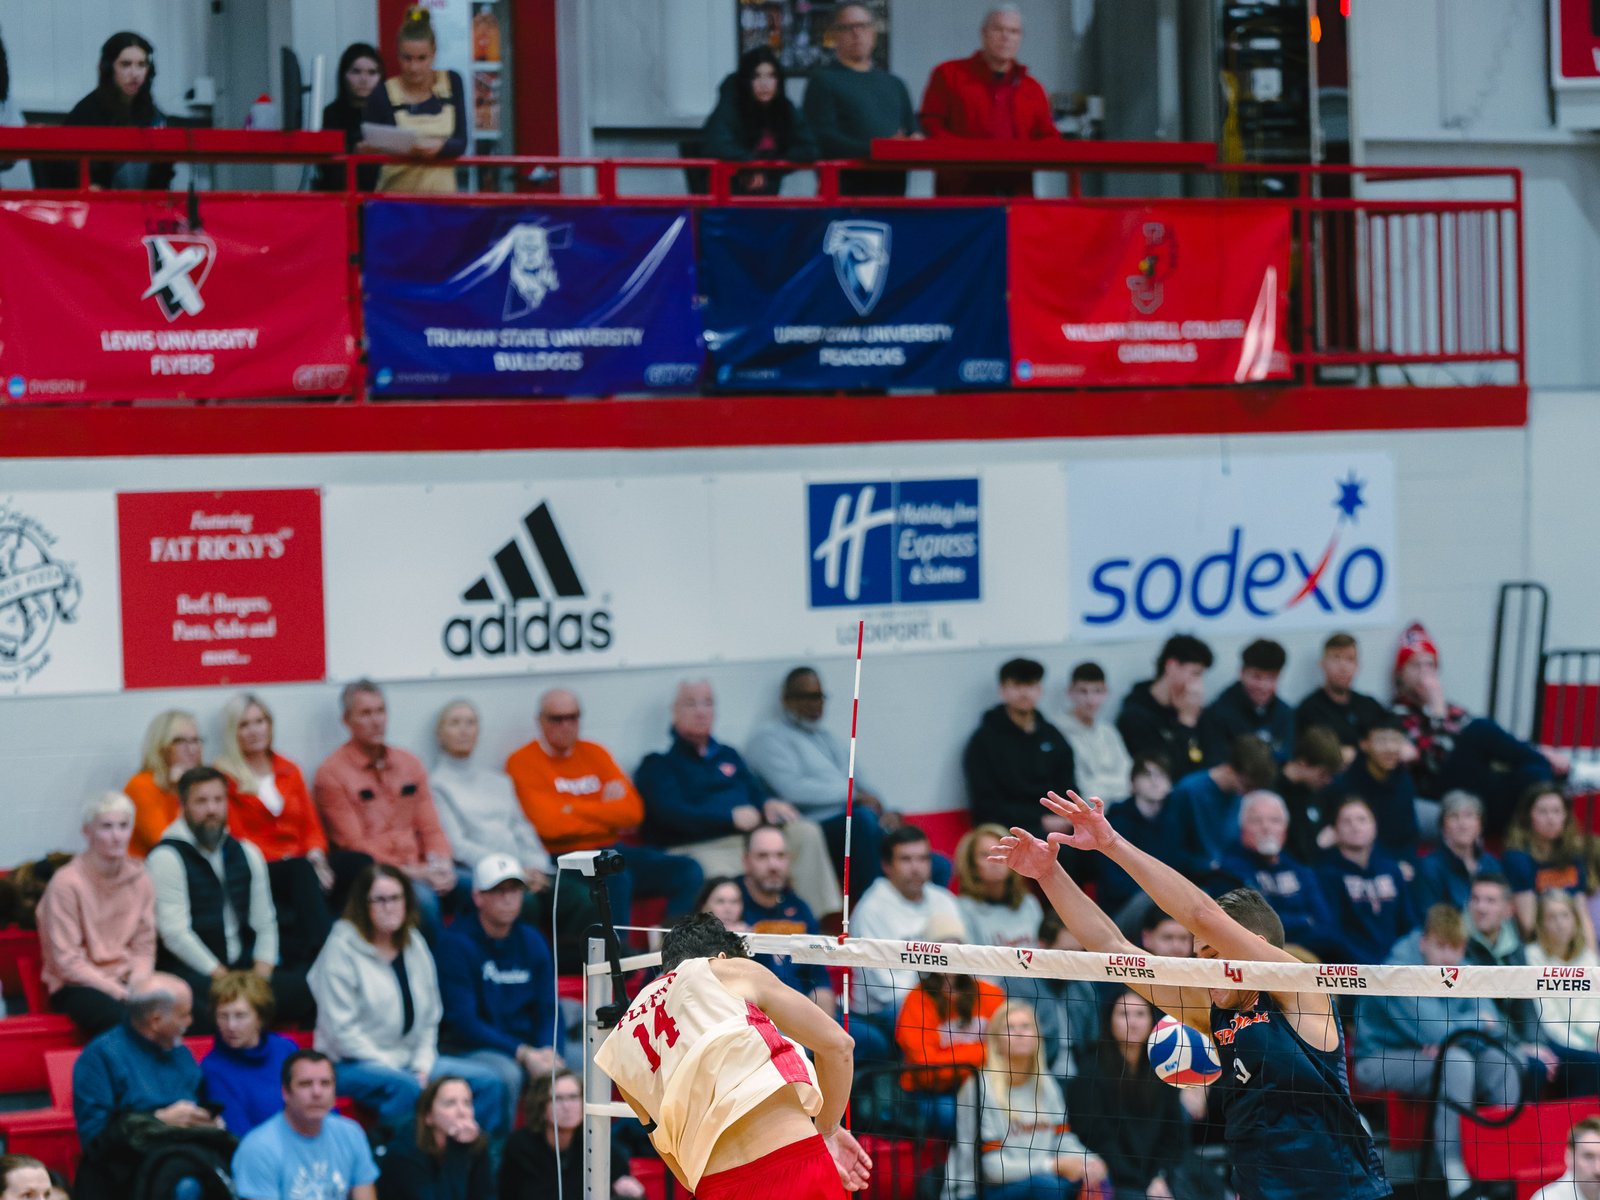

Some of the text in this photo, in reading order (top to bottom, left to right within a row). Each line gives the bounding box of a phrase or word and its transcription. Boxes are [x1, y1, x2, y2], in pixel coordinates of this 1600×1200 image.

[101, 328, 258, 351] LEWIS UNIVERSITY
[424, 327, 644, 347] TRUMAN STATE UNIVERSITY
[151, 354, 214, 376] FLYERS
[150, 534, 285, 562] FAT RICKY'S
[898, 529, 977, 563] Express
[1084, 526, 1384, 624] sodexo
[444, 601, 612, 657] adidas
[906, 942, 942, 953] LEWIS
[901, 953, 948, 966] FLYERS
[1109, 955, 1146, 967] LEWIS
[1105, 966, 1155, 979] FLYERS
[1319, 965, 1358, 976] LEWIS
[1543, 967, 1585, 978] LEWIS
[1316, 976, 1367, 989] FLYERS
[1536, 977, 1591, 991] FLYERS
[633, 999, 680, 1074] 14
